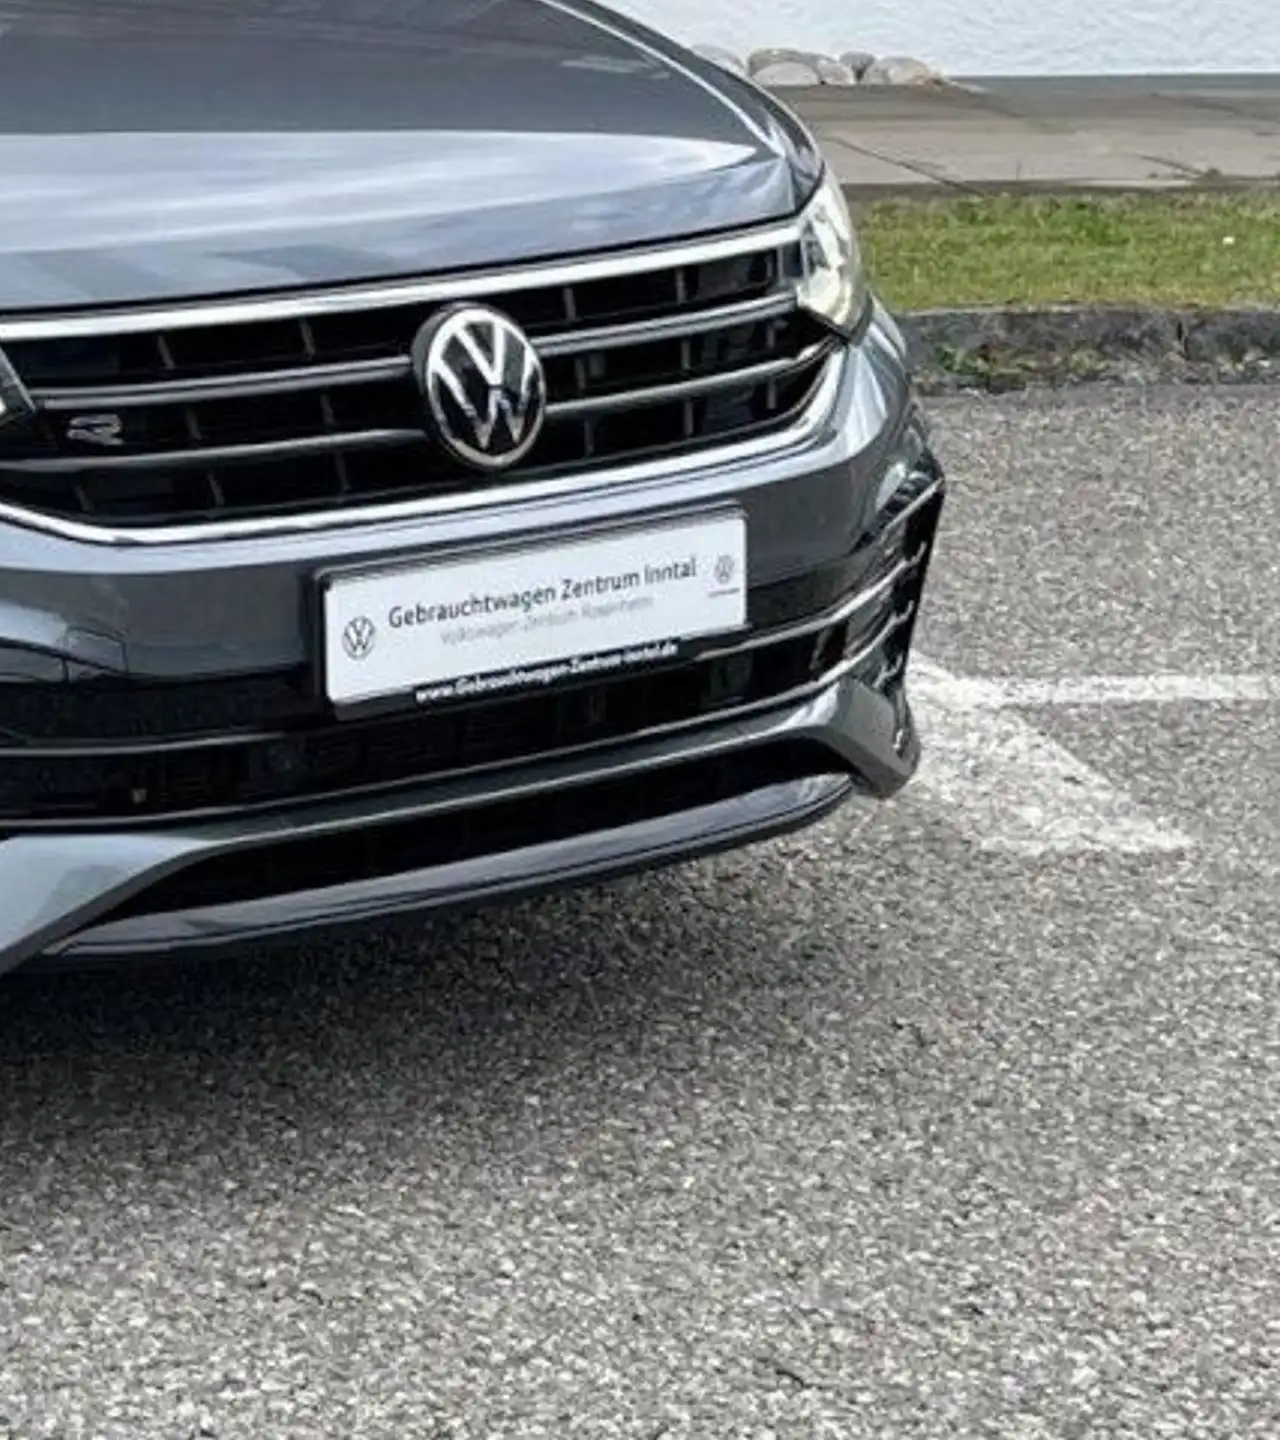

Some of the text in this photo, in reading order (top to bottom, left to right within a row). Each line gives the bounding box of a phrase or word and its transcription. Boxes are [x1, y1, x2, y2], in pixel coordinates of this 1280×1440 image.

[388, 557, 697, 629] Gebrauchtwagen Zentrum Inntal
